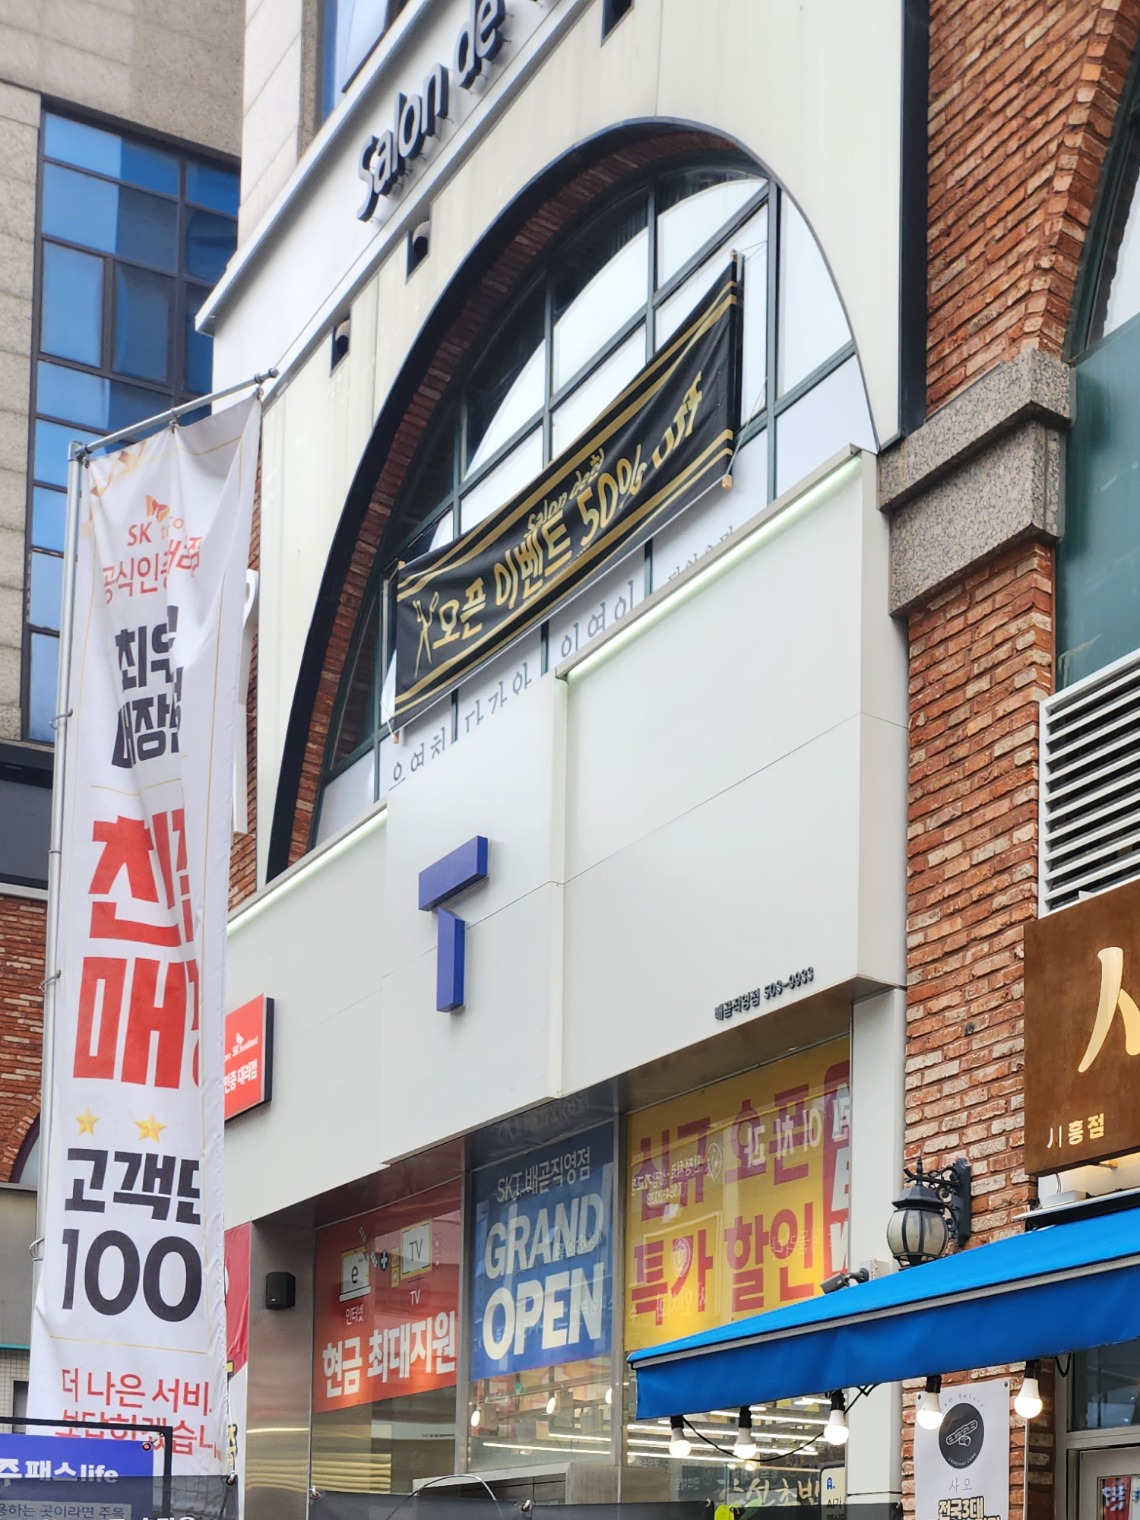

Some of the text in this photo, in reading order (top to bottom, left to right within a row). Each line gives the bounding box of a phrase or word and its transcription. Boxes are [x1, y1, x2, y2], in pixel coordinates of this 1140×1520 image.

[357, 64, 450, 222] Salon
[127, 521, 152, 547] SK
[431, 576, 487, 651] 오픈
[494, 508, 572, 610] 이벤트
[576, 442, 648, 547] 50%
[418, 834, 488, 1013] T
[764, 966, 814, 1001] 503-9933
[61, 1228, 202, 1323] 100
[484, 1191, 605, 1282] GRAND
[630, 1201, 815, 1326] 특가 할인
[322, 1310, 456, 1399] 현금 최대지원
[481, 1261, 604, 1361] OPEN
[62, 1368, 213, 1417] 더 나은 서비
[937, 1497, 984, 1520] 전국3대
